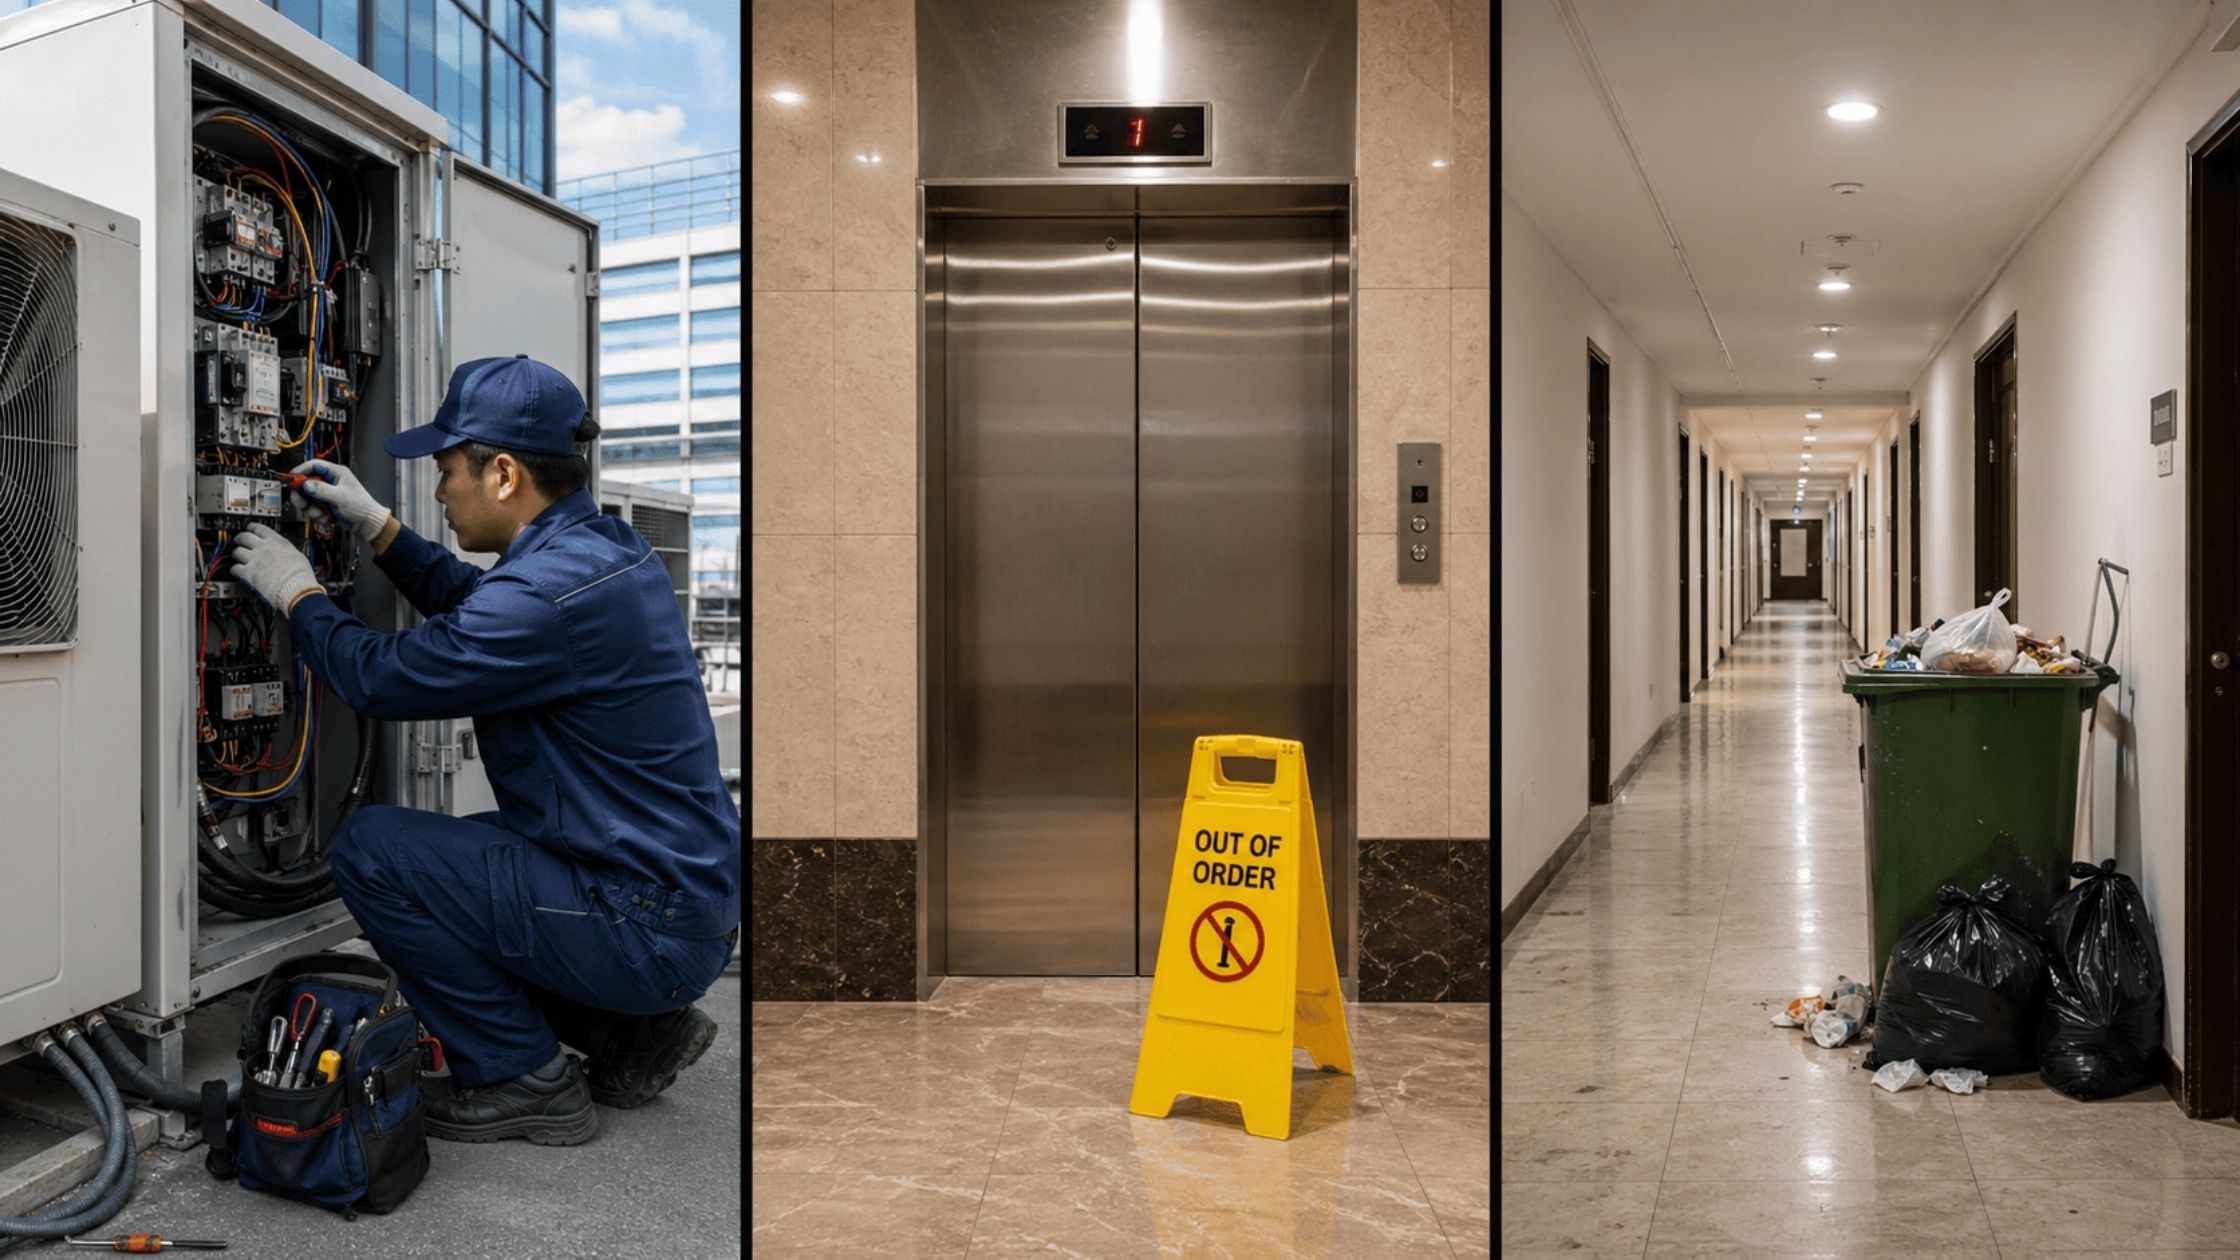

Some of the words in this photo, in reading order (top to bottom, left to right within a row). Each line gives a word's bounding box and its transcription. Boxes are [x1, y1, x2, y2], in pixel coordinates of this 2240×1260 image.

[1195, 829, 1244, 855] OUT
[1249, 834, 1282, 858] OF
[1193, 860, 1276, 890] ORDER
